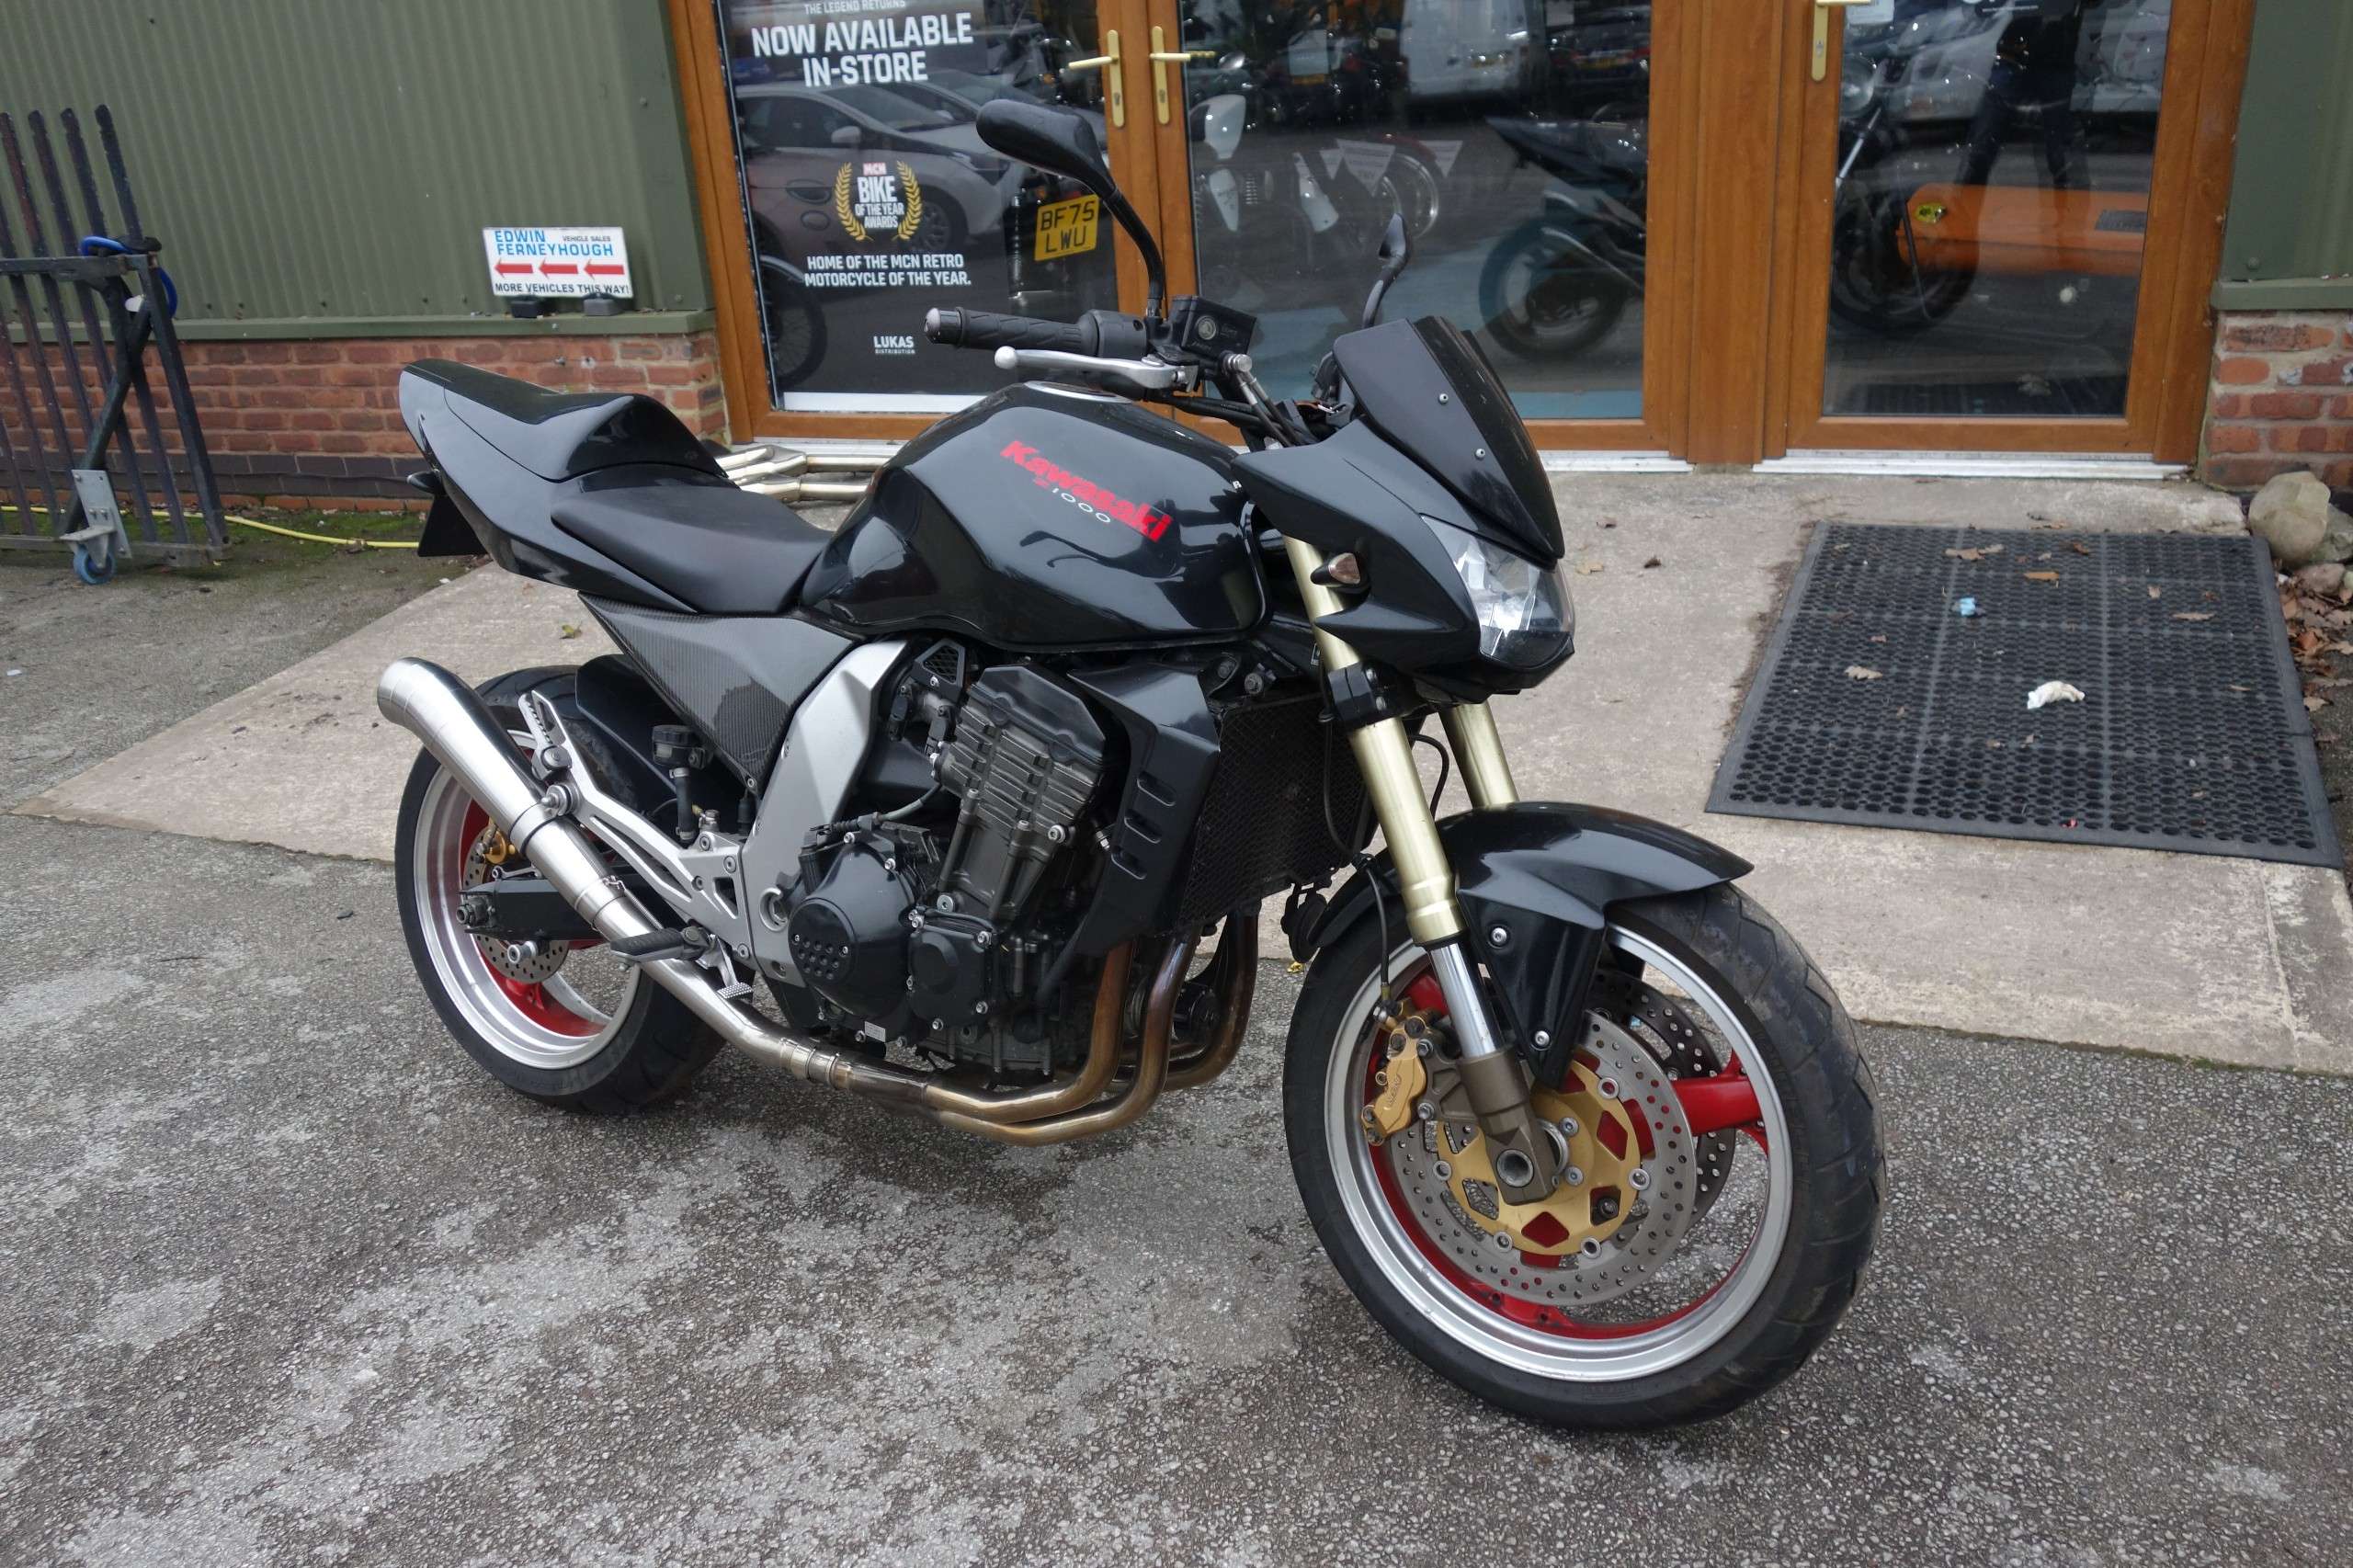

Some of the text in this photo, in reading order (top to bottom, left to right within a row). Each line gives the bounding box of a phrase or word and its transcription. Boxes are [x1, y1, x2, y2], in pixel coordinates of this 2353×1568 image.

[804, 0, 906, 15] THE LEGEND RETURNS
[751, 12, 974, 58] NOW AVAILABLE
[801, 51, 929, 88] IN-STORE
[857, 176, 898, 203] BIKE
[855, 202, 904, 217] OF THE YEAR
[1040, 200, 1097, 232] BF75
[864, 215, 899, 229] AWARDS
[494, 231, 546, 243] EDWIN
[1044, 225, 1087, 253] LWU
[497, 244, 614, 256] FERNEYHOUGH
[806, 254, 964, 270] HOME OF THE MCN RETRO
[804, 271, 972, 288] MOTORCYCLE OF THE YEAR.
[494, 283, 630, 294] MORE VEHICLES THIS WAY!
[873, 335, 915, 348] LUKAS
